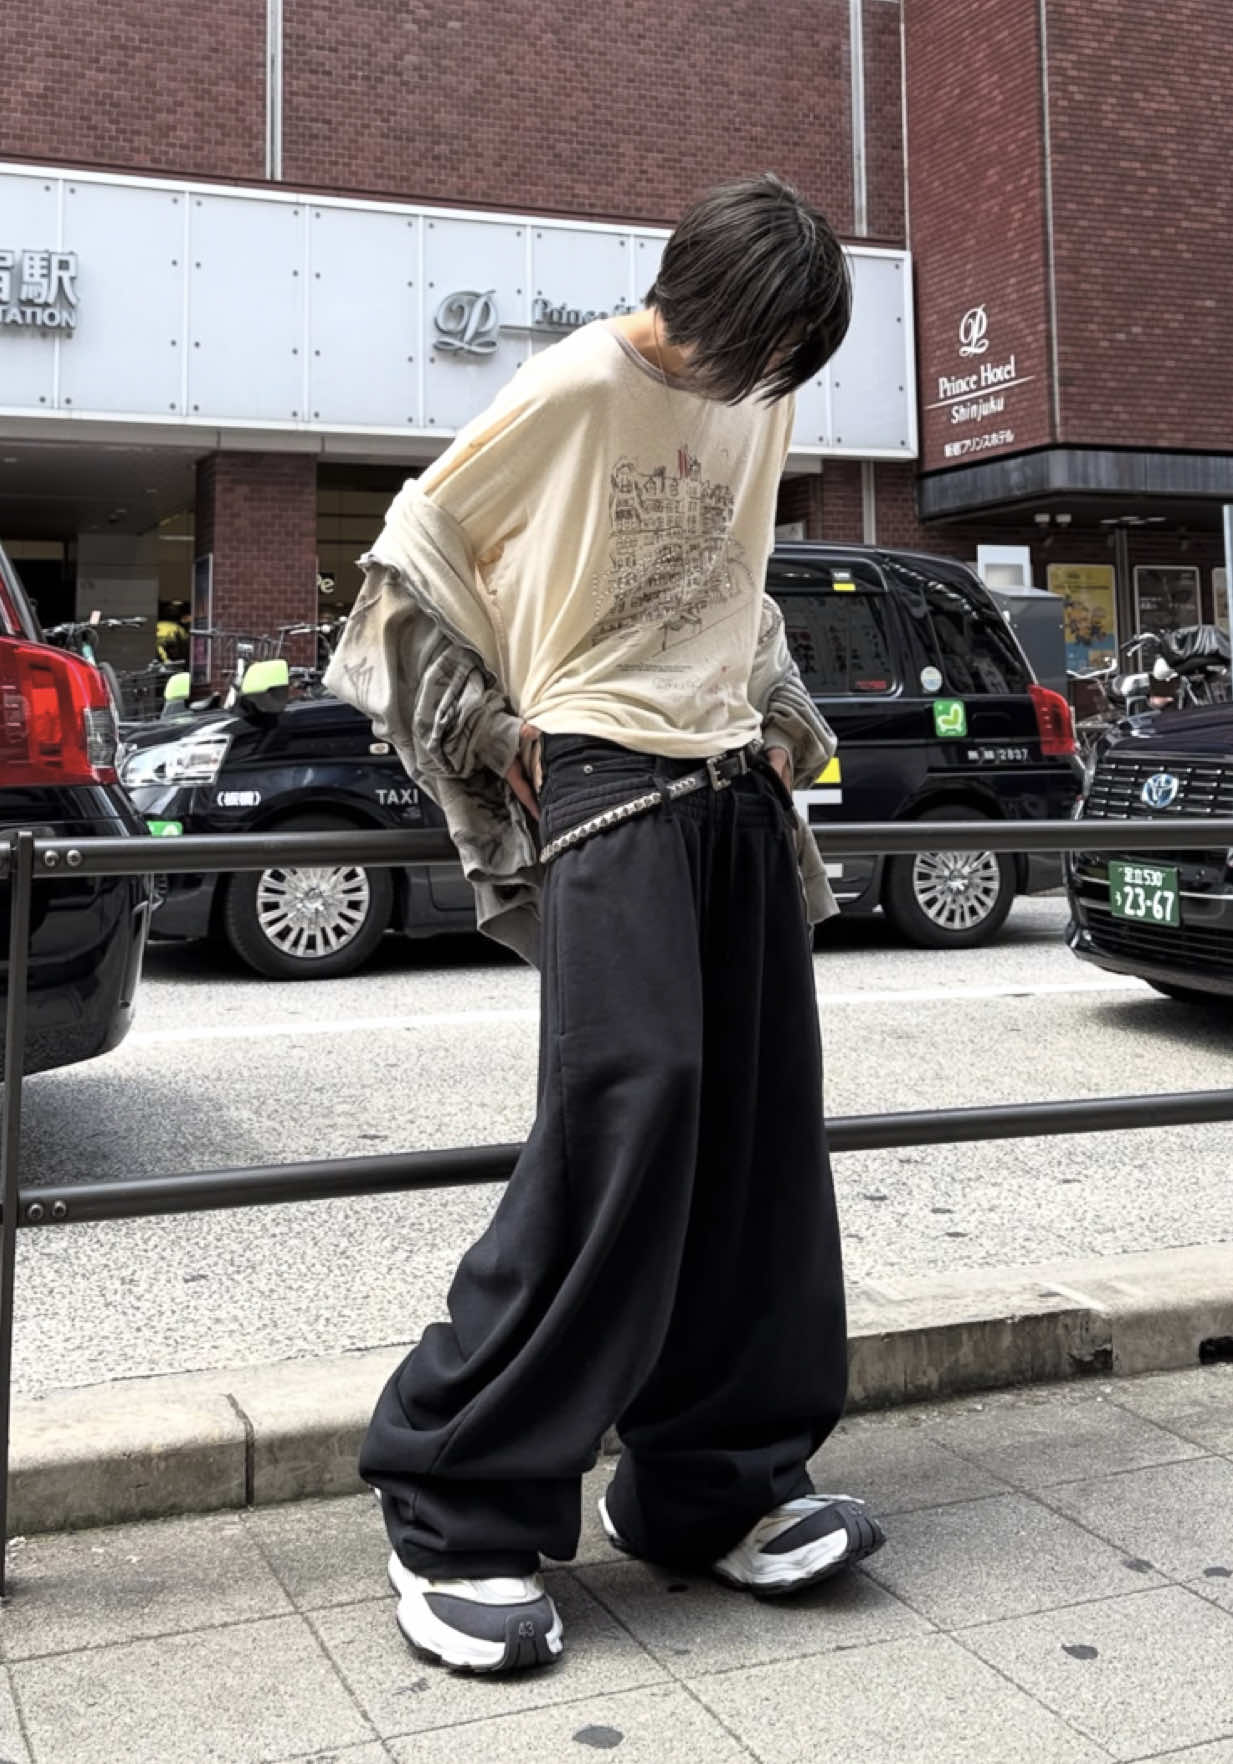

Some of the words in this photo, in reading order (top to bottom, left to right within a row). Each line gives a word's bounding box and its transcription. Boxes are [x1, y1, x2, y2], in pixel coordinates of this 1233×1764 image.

[938, 374, 979, 399] Prince
[980, 354, 1016, 387] Hotel
[951, 396, 1005, 424] Shinjuku
[376, 789, 419, 805] TAXI
[1123, 886, 1175, 921] 23-67
[519, 1621, 535, 1638] 43
